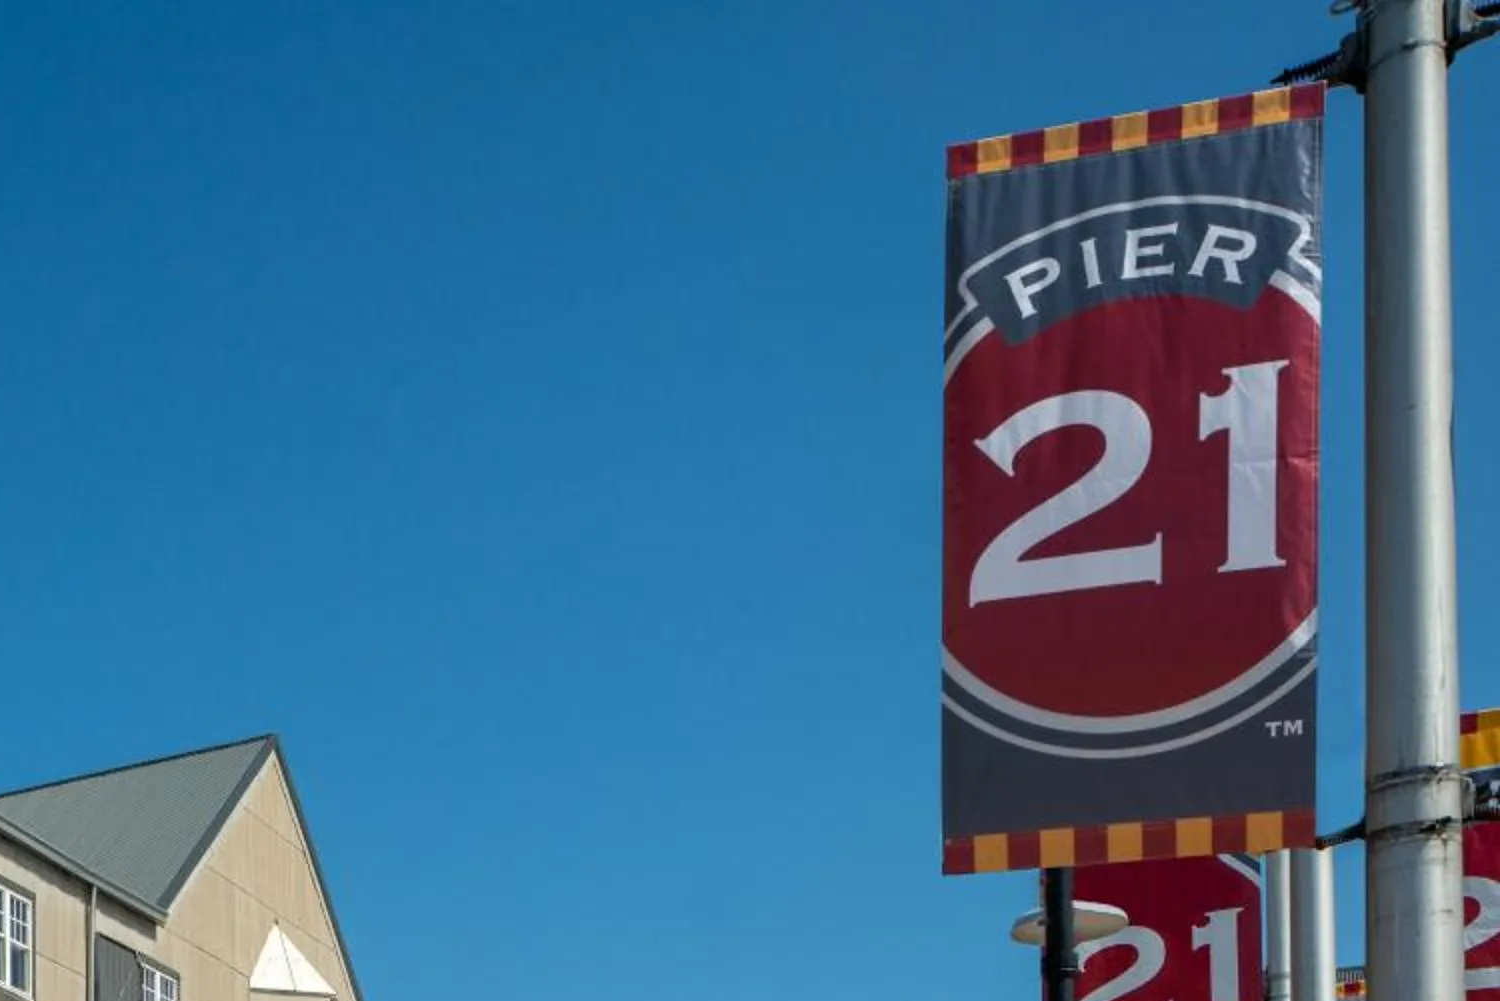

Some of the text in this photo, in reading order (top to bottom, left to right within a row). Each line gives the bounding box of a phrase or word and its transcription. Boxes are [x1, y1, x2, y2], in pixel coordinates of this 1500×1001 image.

[1003, 221, 1257, 319] PIER
[969, 359, 1290, 608] 21
[1265, 719, 1304, 737] TM
